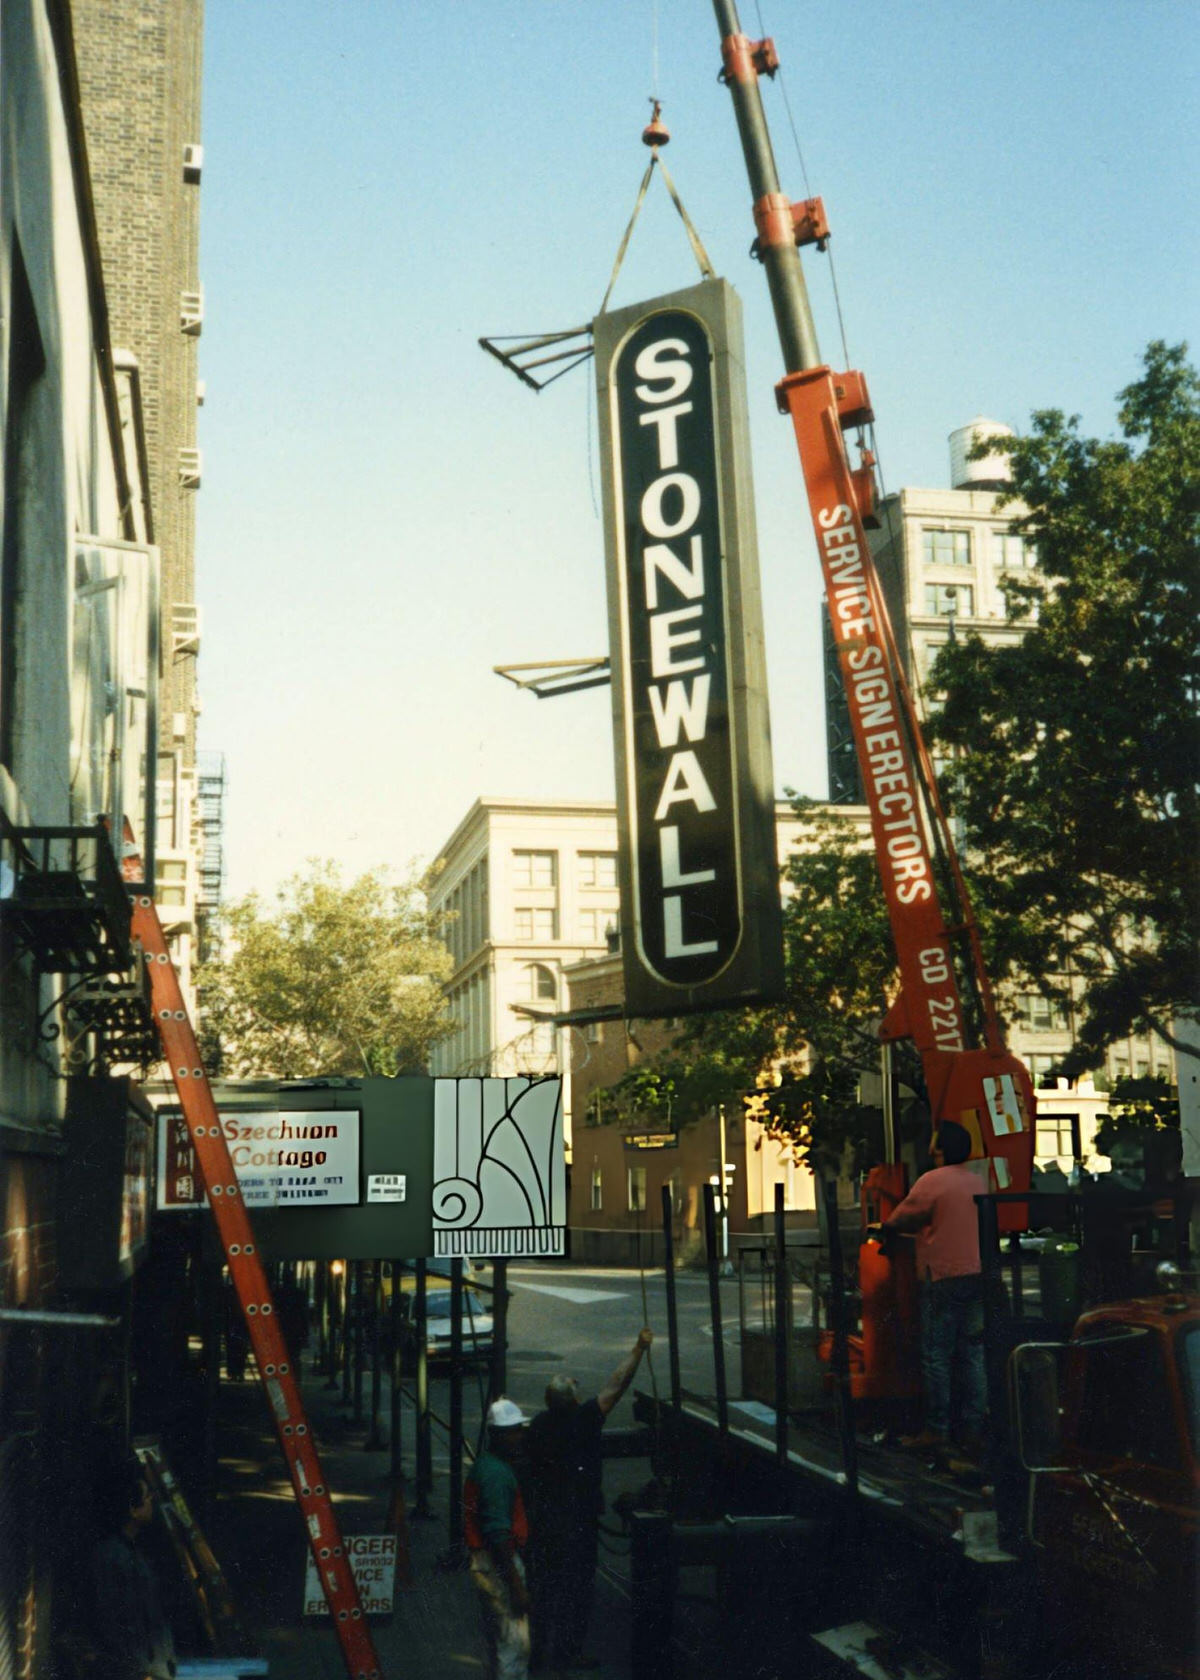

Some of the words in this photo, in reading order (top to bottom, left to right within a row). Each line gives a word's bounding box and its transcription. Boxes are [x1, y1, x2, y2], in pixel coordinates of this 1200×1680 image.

[818, 502, 877, 643] SERVICE
[634, 337, 719, 960] STONEWALL
[847, 643, 896, 727] SIGN
[865, 730, 932, 907] ERECTORS
[918, 947, 949, 985] CD
[927, 995, 964, 1055] 2217
